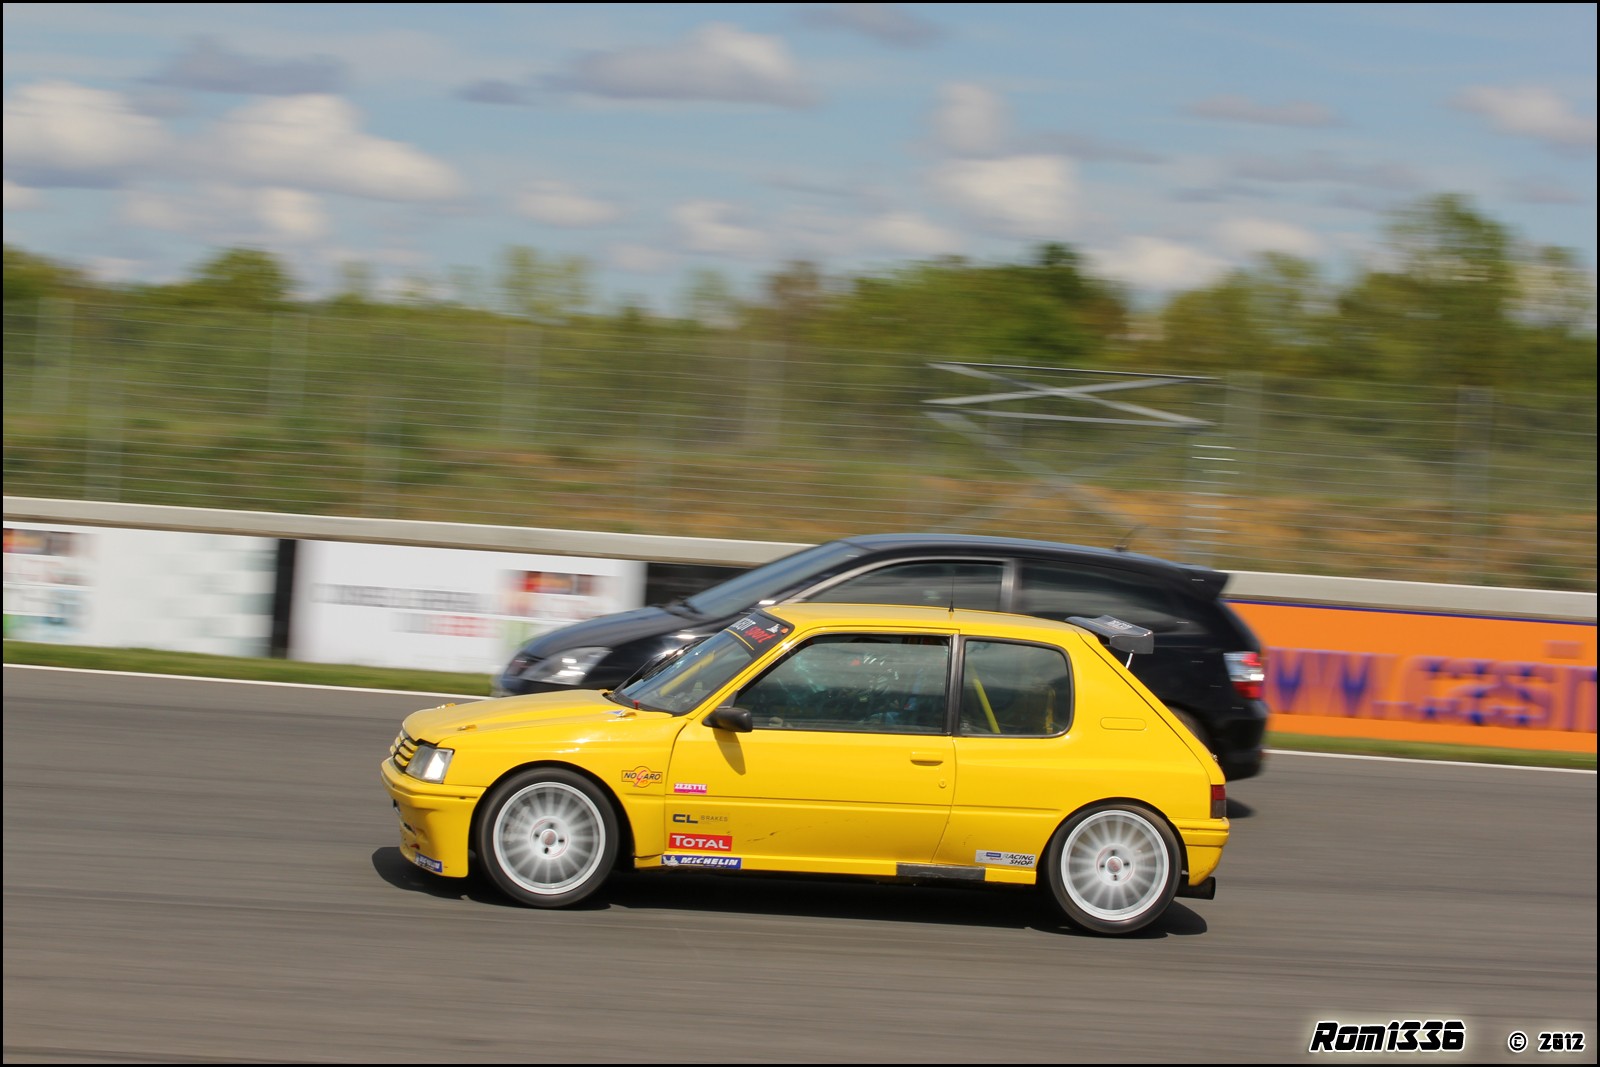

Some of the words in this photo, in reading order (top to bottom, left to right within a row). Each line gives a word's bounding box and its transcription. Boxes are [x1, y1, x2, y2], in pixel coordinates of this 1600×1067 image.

[623, 769, 661, 787] NOGARO
[672, 813, 698, 824] CL
[680, 856, 738, 866] MICHELIN
